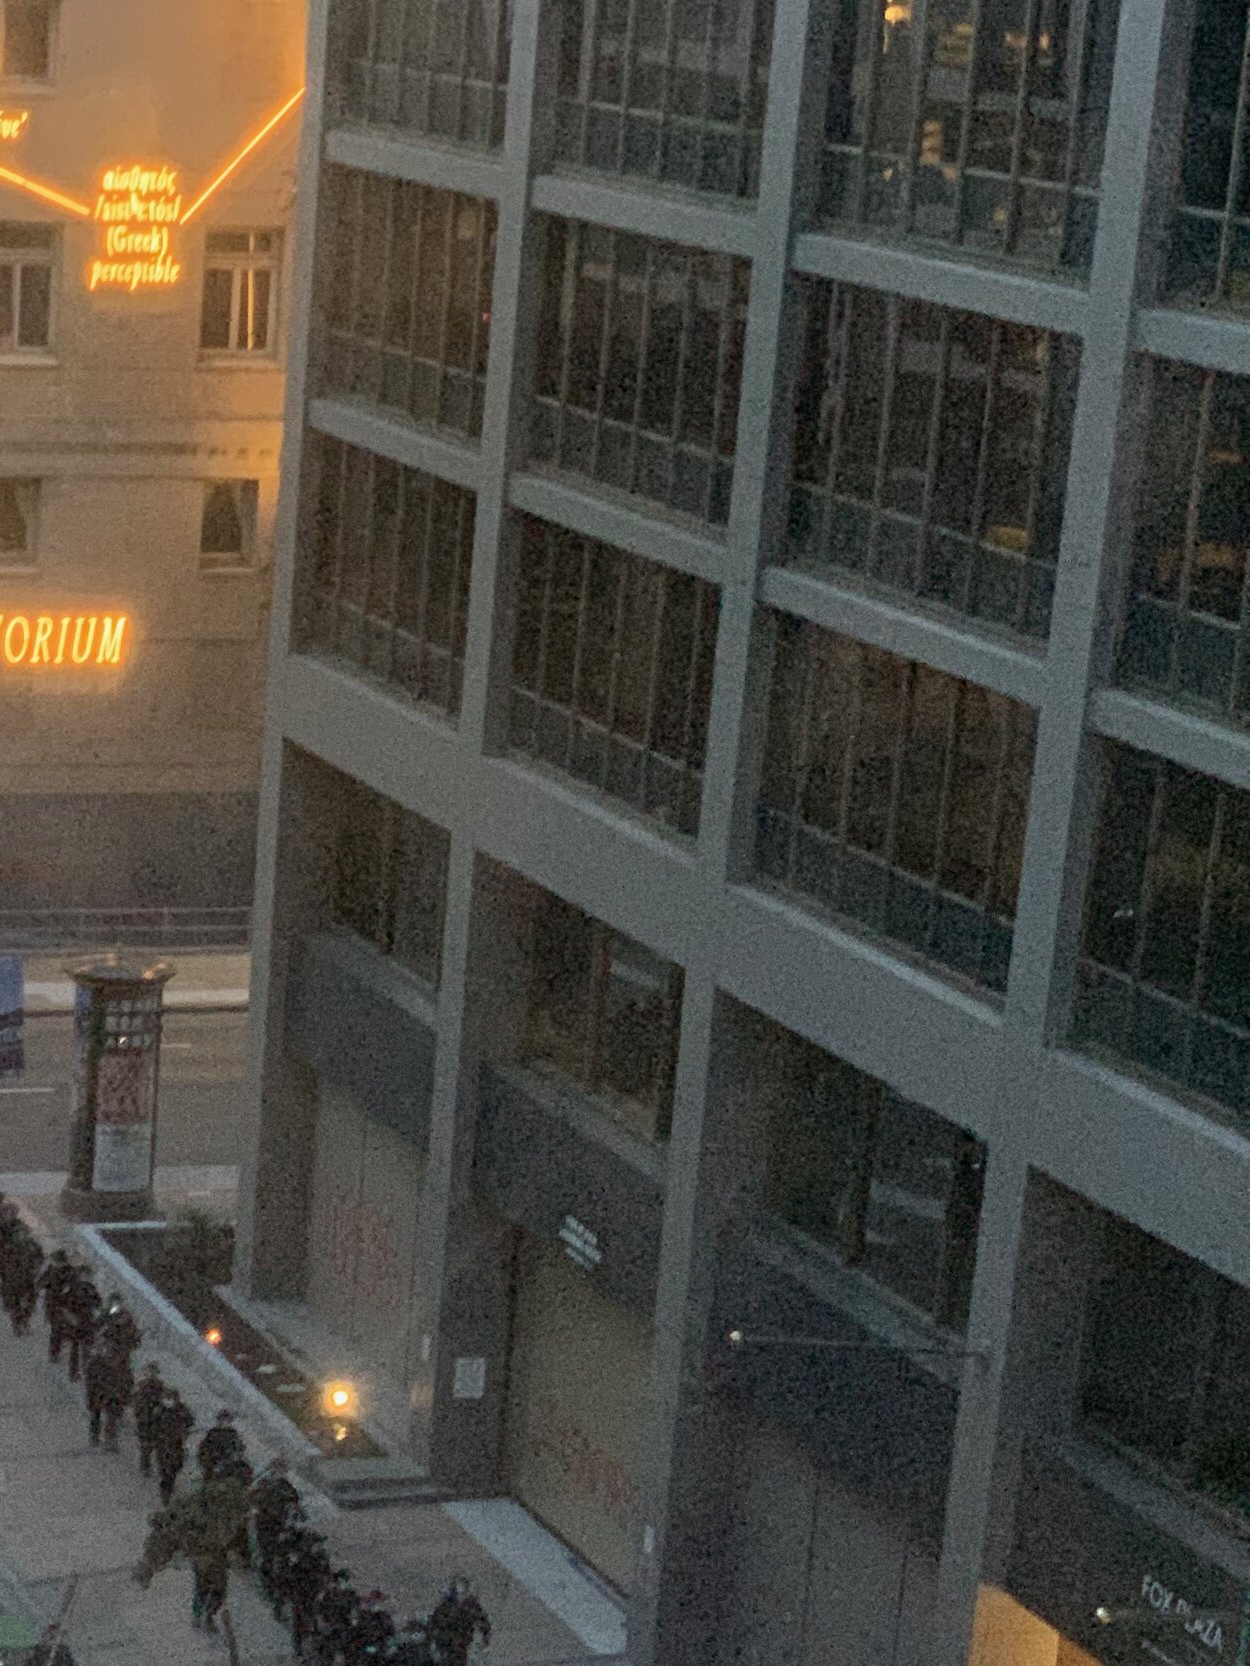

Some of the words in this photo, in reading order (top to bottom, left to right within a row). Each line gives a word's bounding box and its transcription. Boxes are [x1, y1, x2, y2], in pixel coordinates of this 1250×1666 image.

[106, 225, 169, 257] (Greek)
[89, 255, 181, 291] perceptible
[1141, 1575, 1174, 1614] FOX
